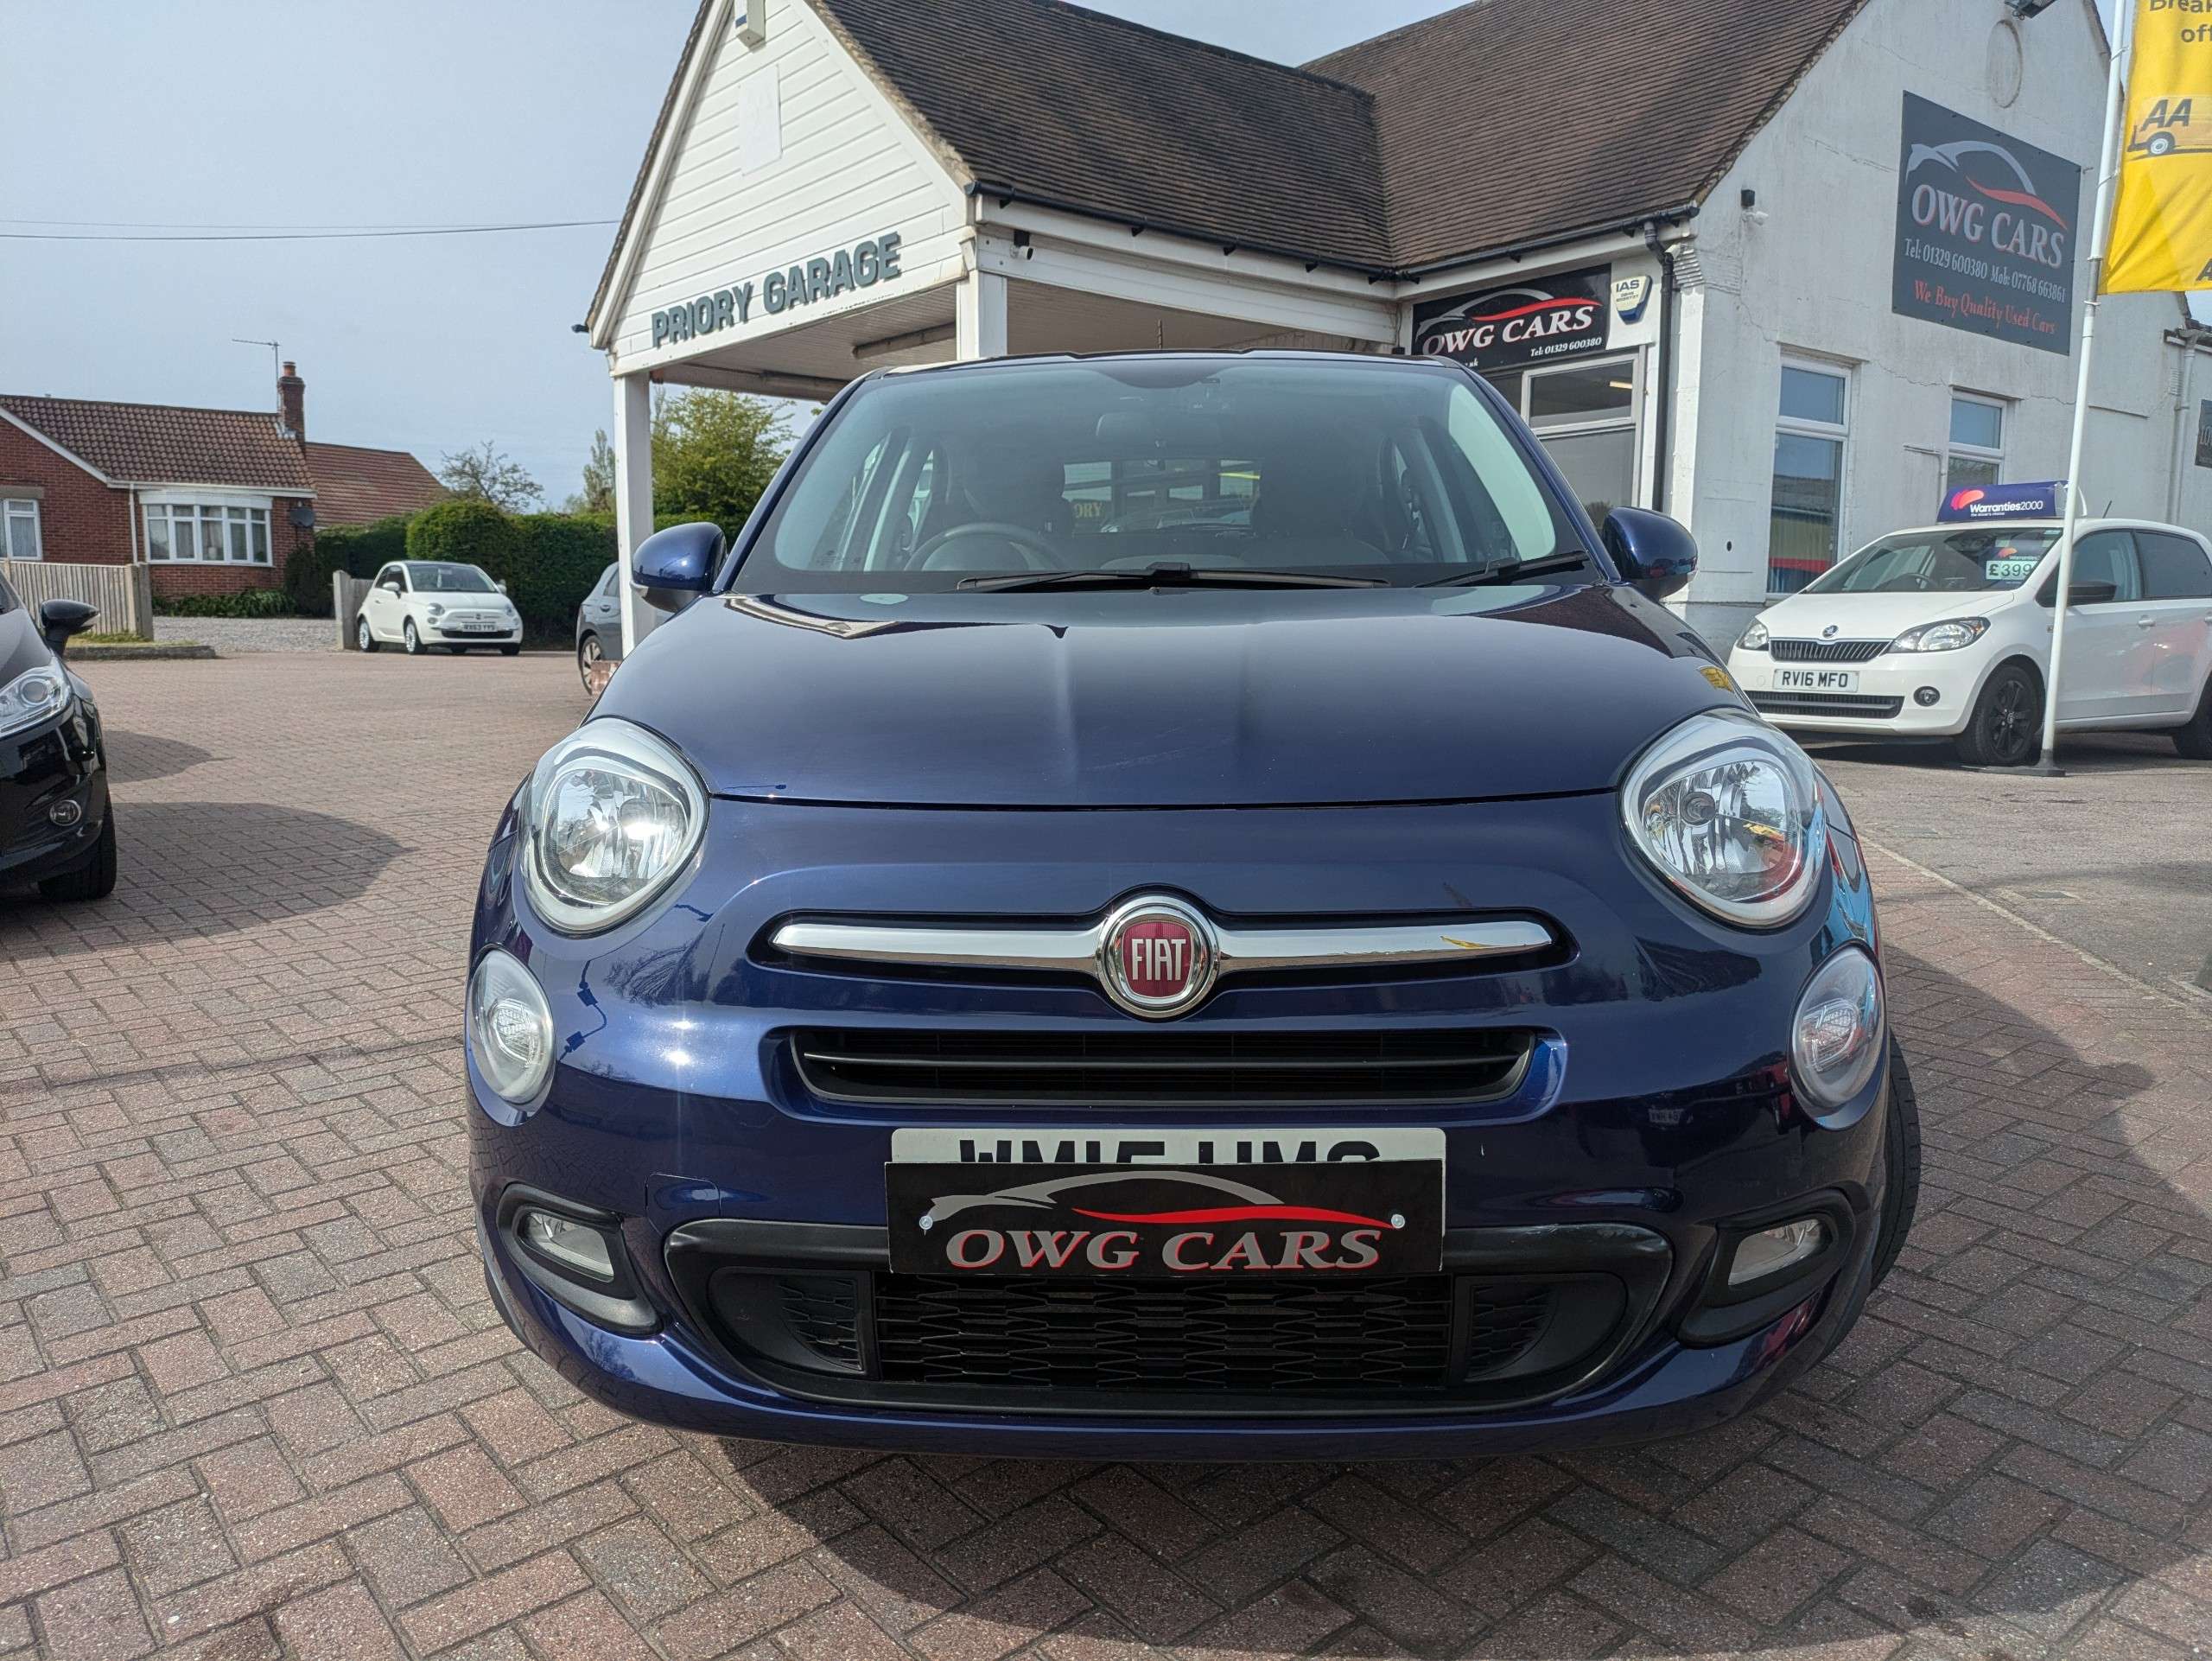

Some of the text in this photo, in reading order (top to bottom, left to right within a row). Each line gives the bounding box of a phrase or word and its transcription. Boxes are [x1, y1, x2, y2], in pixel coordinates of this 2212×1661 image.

[2142, 99, 2191, 131] AA
[1911, 184, 2064, 268] OWG CARS
[1616, 279, 1640, 293] IAS
[1904, 238, 1921, 259] Tel:
[1923, 245, 1950, 268] 01329
[1951, 253, 1987, 279] 600380
[1990, 264, 2011, 285] Mob:
[2012, 270, 2037, 294] 07768
[652, 231, 901, 348] PRIORY GARAGE
[1914, 279, 2056, 334] We Buy Quality Used Cars
[1422, 305, 1593, 355] OWG CARS
[1530, 337, 1602, 357] Tel: 01329 600380
[1970, 500, 2044, 512] Warranties2000
[1782, 671, 1848, 688] RV16 MFO
[1131, 939, 1186, 981] FIAT
[945, 1230, 1382, 1271] OWG CARS
